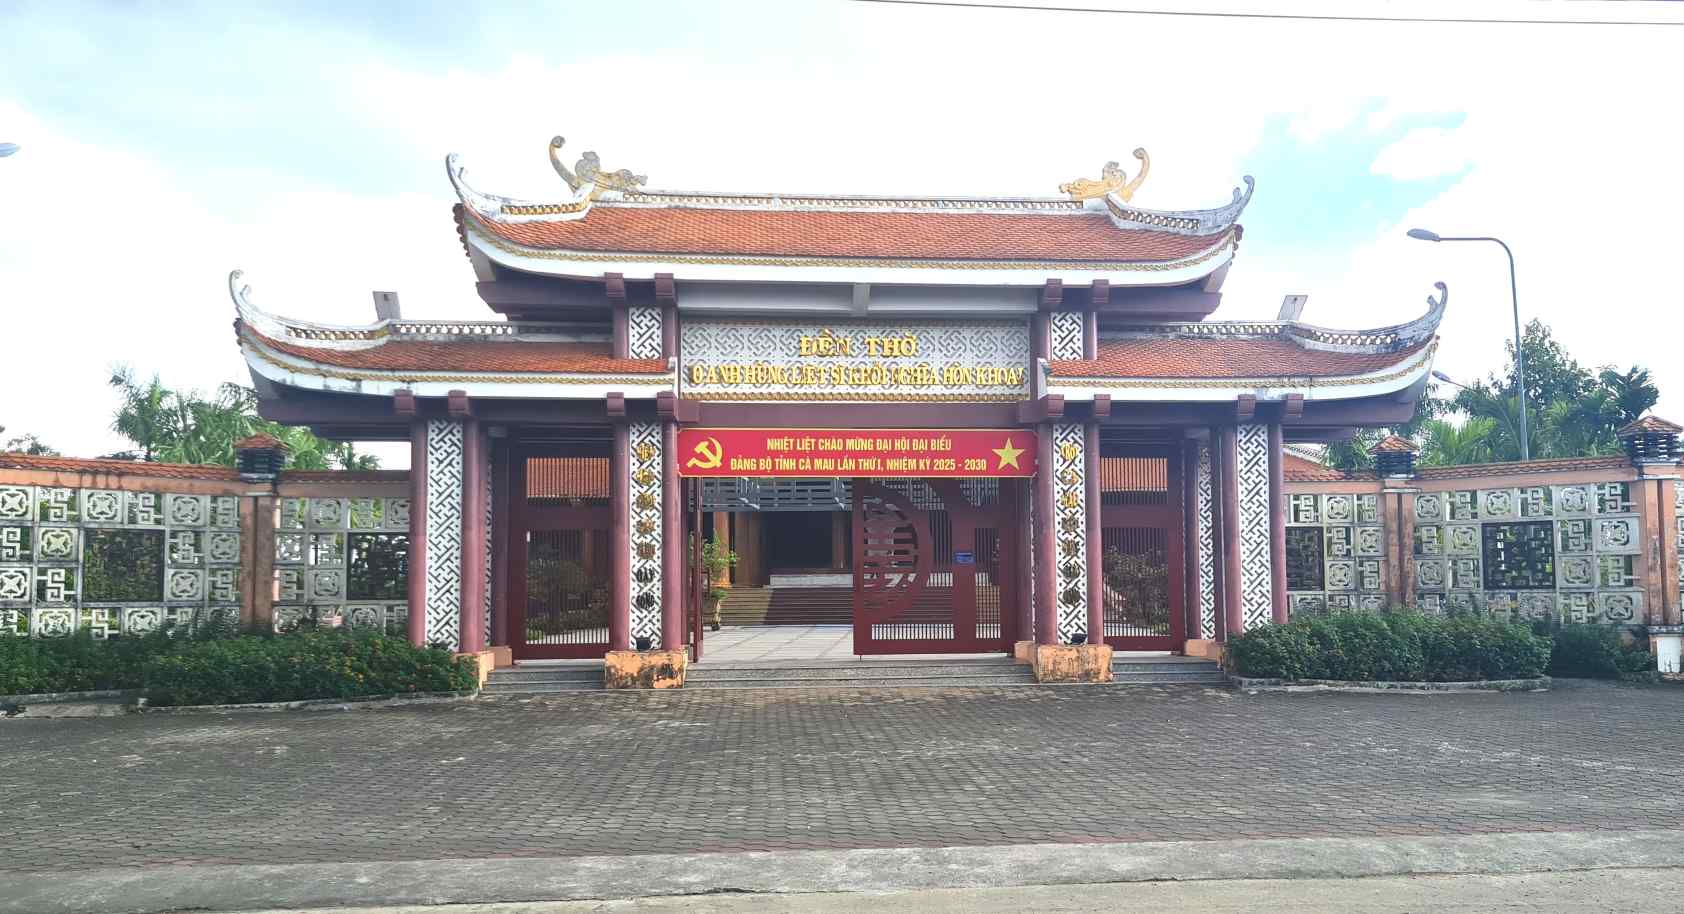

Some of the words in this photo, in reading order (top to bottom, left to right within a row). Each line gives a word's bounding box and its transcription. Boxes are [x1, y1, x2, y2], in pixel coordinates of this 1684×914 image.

[800, 329, 851, 357] ĐỀN
[865, 332, 917, 357] THỜ
[706, 365, 741, 384] ANH
[744, 362, 789, 385] HÙNG
[891, 362, 940, 385] NGHĨA
[943, 362, 973, 385] HÒN
[767, 436, 794, 453] NHIỆT
[796, 436, 816, 453] LIỆT
[818, 436, 844, 451] CHÀO
[846, 436, 874, 451] MỪNG
[876, 438, 891, 454] ĐẠI
[894, 436, 910, 454] HỘI
[912, 438, 928, 454] ĐẠI
[931, 434, 952, 451] BIỂU
[730, 455, 757, 471] ĐẢNG
[760, 455, 772, 472] BỘ
[775, 455, 796, 471] TỈNH
[799, 455, 812, 471] CÀ
[814, 458, 834, 471] MAU
[837, 455, 856, 471] LẦN
[886, 456, 917, 472] NHIỆM
[933, 458, 956, 471] 2025
[964, 458, 987, 471] 2030
